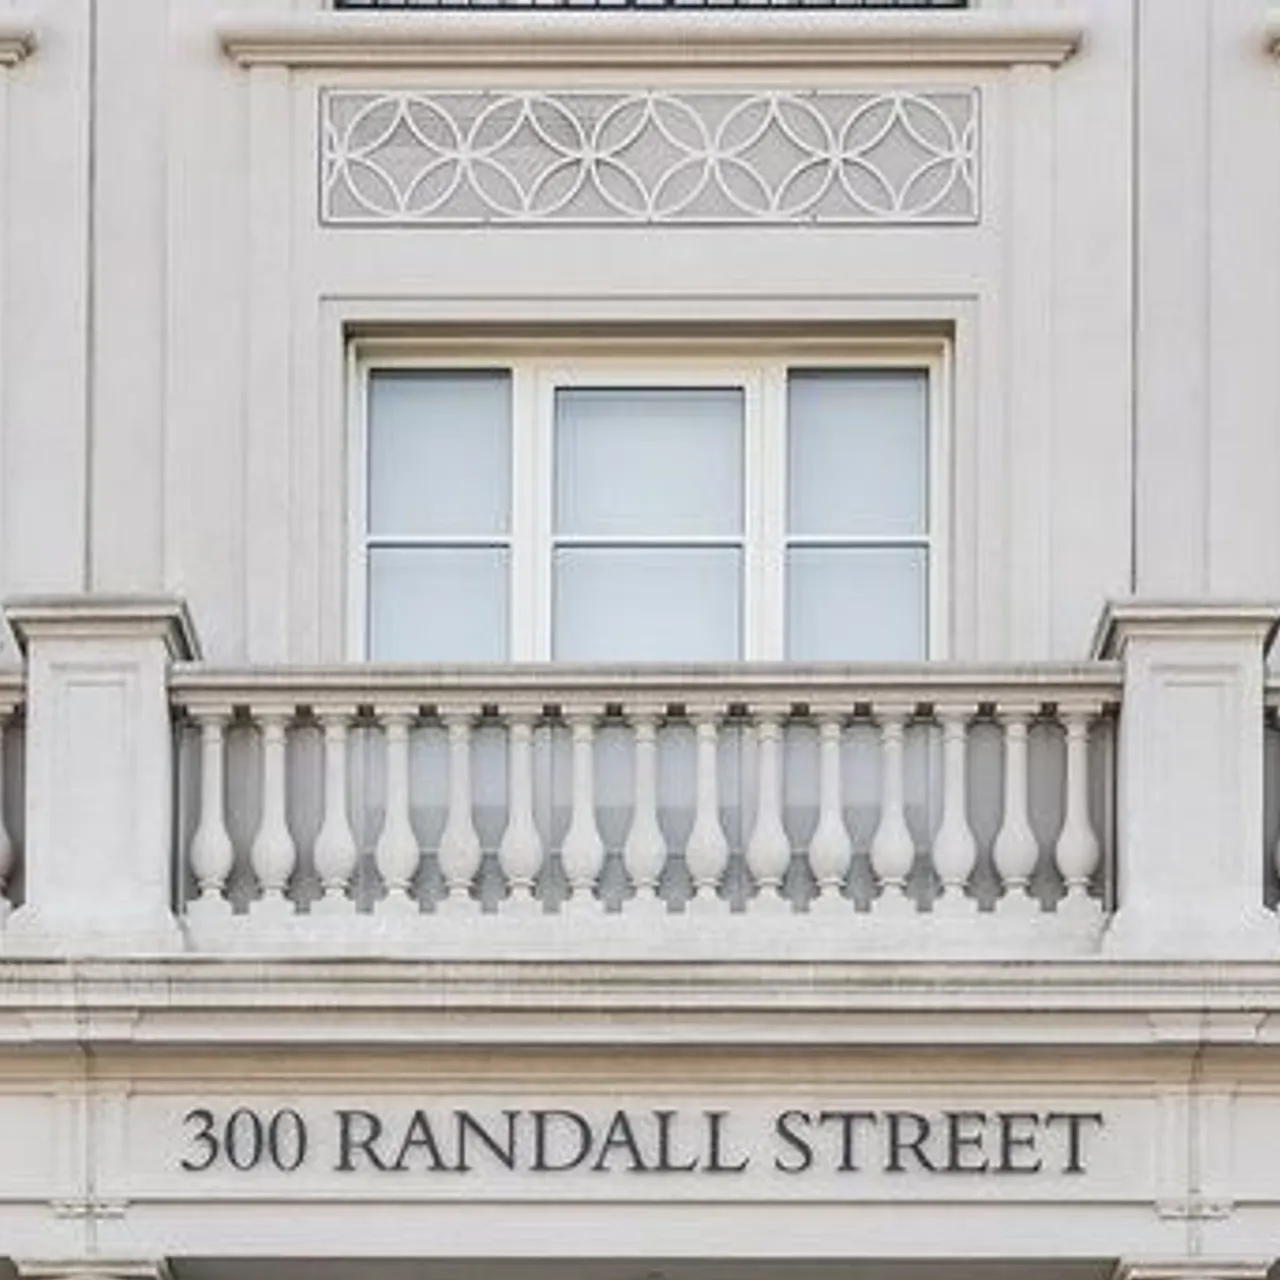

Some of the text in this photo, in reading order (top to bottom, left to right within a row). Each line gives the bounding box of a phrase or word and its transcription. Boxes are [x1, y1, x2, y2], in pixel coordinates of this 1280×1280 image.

[180, 1108, 1105, 1174] 300 RANDALL STREET
